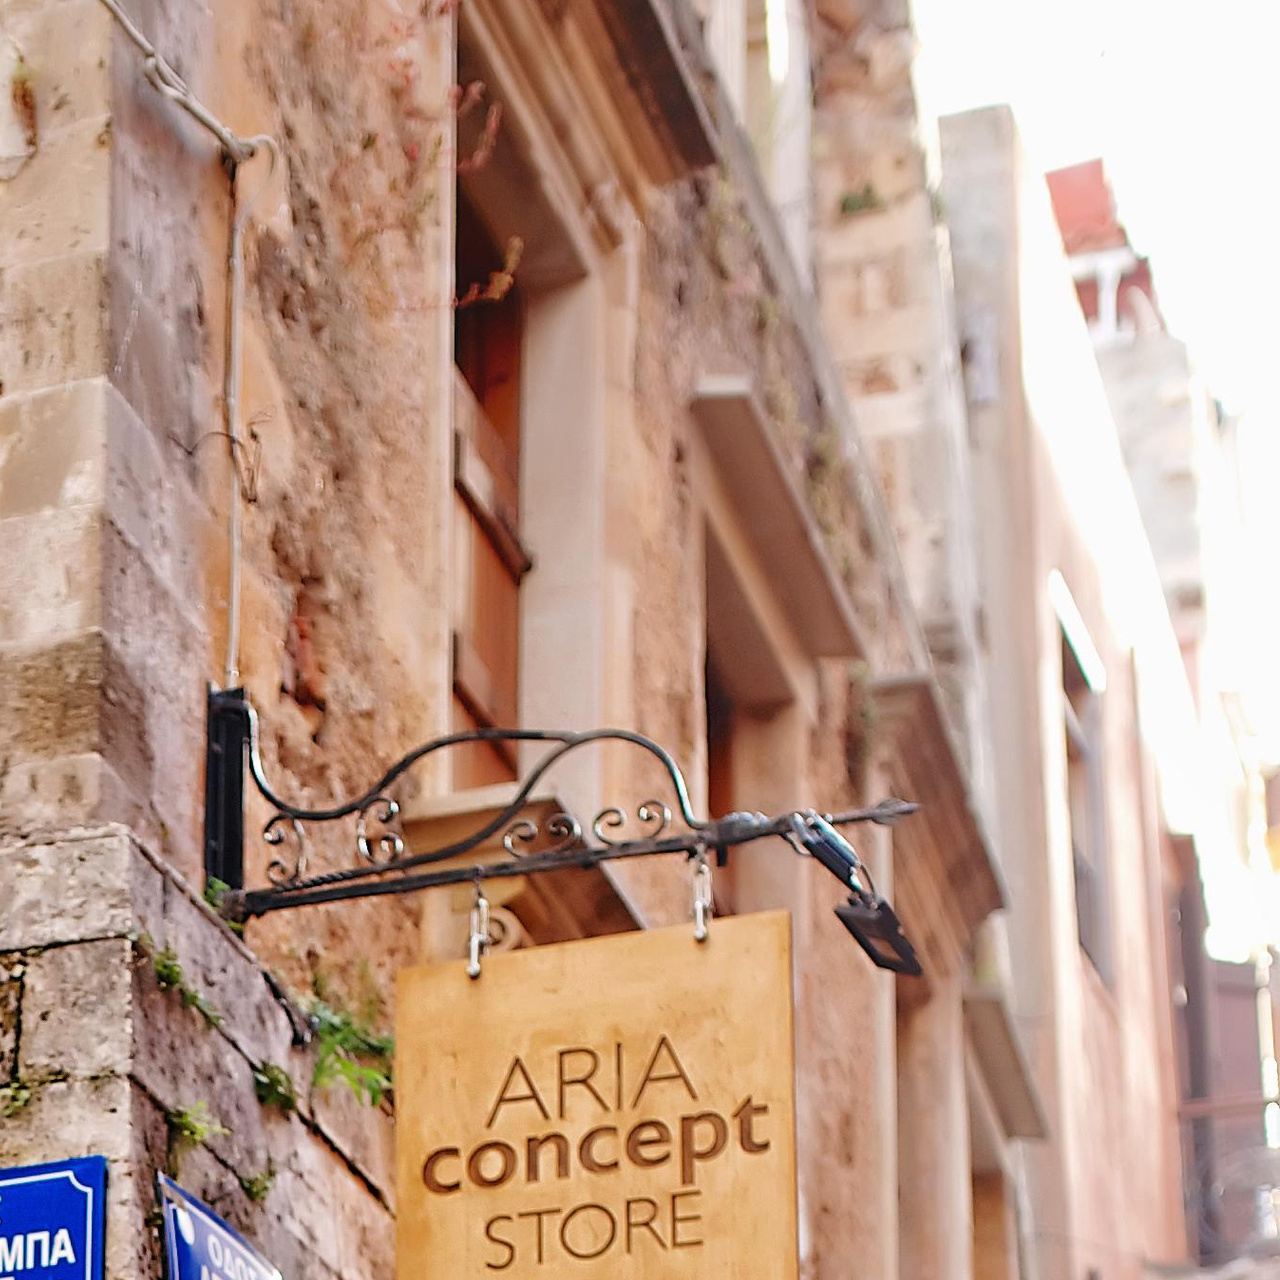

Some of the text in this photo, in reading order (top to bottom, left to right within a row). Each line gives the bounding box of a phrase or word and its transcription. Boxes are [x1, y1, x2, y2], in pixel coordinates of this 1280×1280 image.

[485, 1032, 699, 1129] ARIA
[421, 1094, 771, 1194] concept
[485, 1188, 704, 1271] STORE
